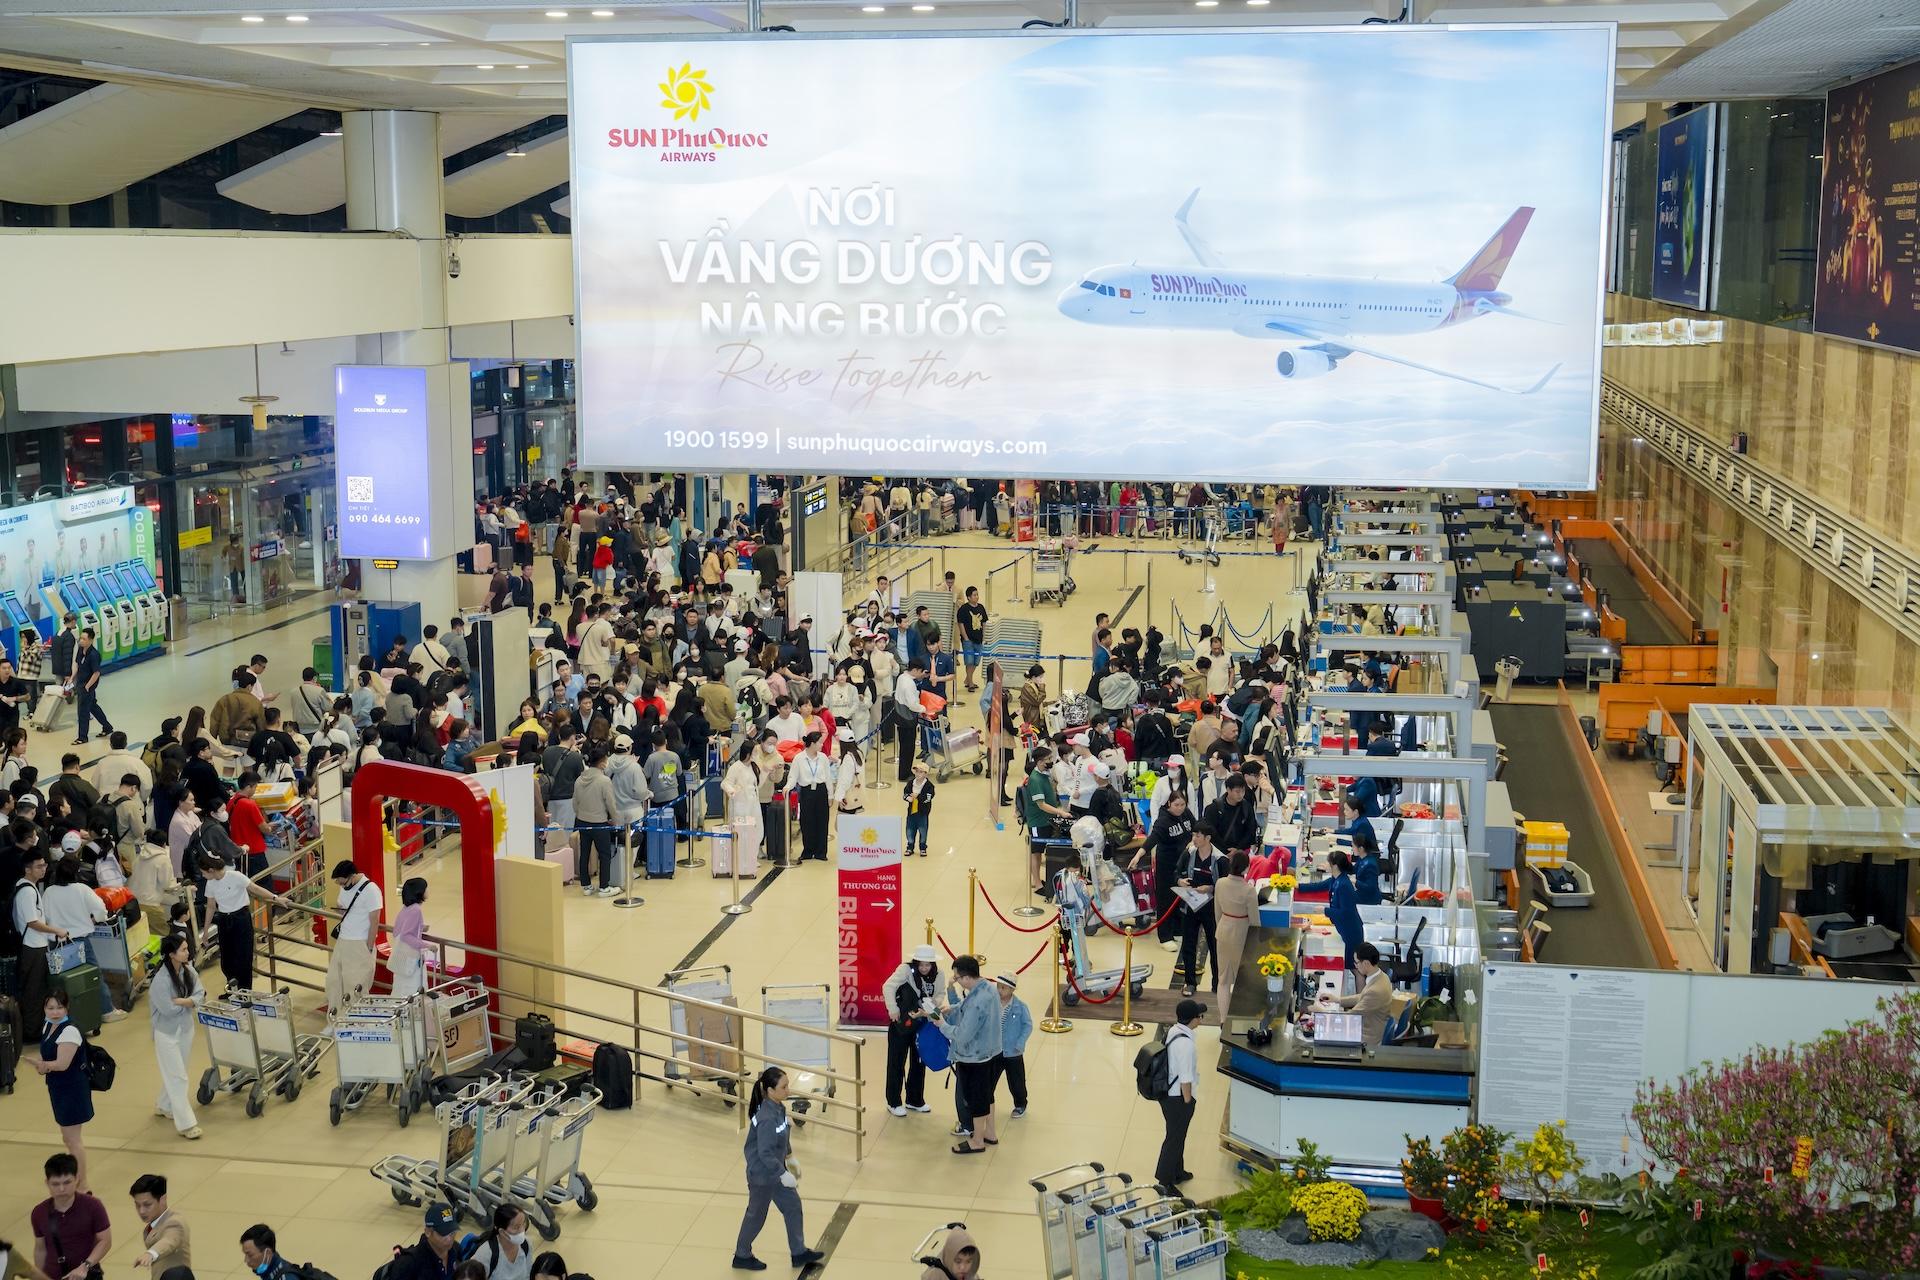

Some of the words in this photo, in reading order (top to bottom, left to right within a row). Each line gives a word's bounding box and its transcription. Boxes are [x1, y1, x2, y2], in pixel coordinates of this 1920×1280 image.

[608, 128, 657, 147] SUN
[661, 127, 768, 149] PhuQuoc
[660, 152, 716, 162] AIRWAYS
[808, 181, 895, 226] NƠI
[657, 218, 822, 284] VẦNG
[837, 233, 1053, 286] DƯƠNG
[1151, 274, 1182, 293] SUN
[1182, 275, 1247, 297] PhuQuoc
[700, 291, 846, 338] NÂNG
[859, 290, 1008, 339] BƯỚC
[715, 338, 824, 393] Rise
[829, 349, 992, 414] together
[663, 430, 715, 449] 1900
[719, 431, 769, 449] 1599
[787, 433, 1048, 457] sunphuquocairways.com
[96, 495, 120, 509] AIRWAYS
[349, 514, 368, 523] 090
[371, 514, 391, 523] 464
[394, 515, 421, 524] 6699
[877, 874, 896, 882] HẠNG
[838, 896, 859, 1020] BUSINESS
[862, 994, 885, 1002] CLAS
